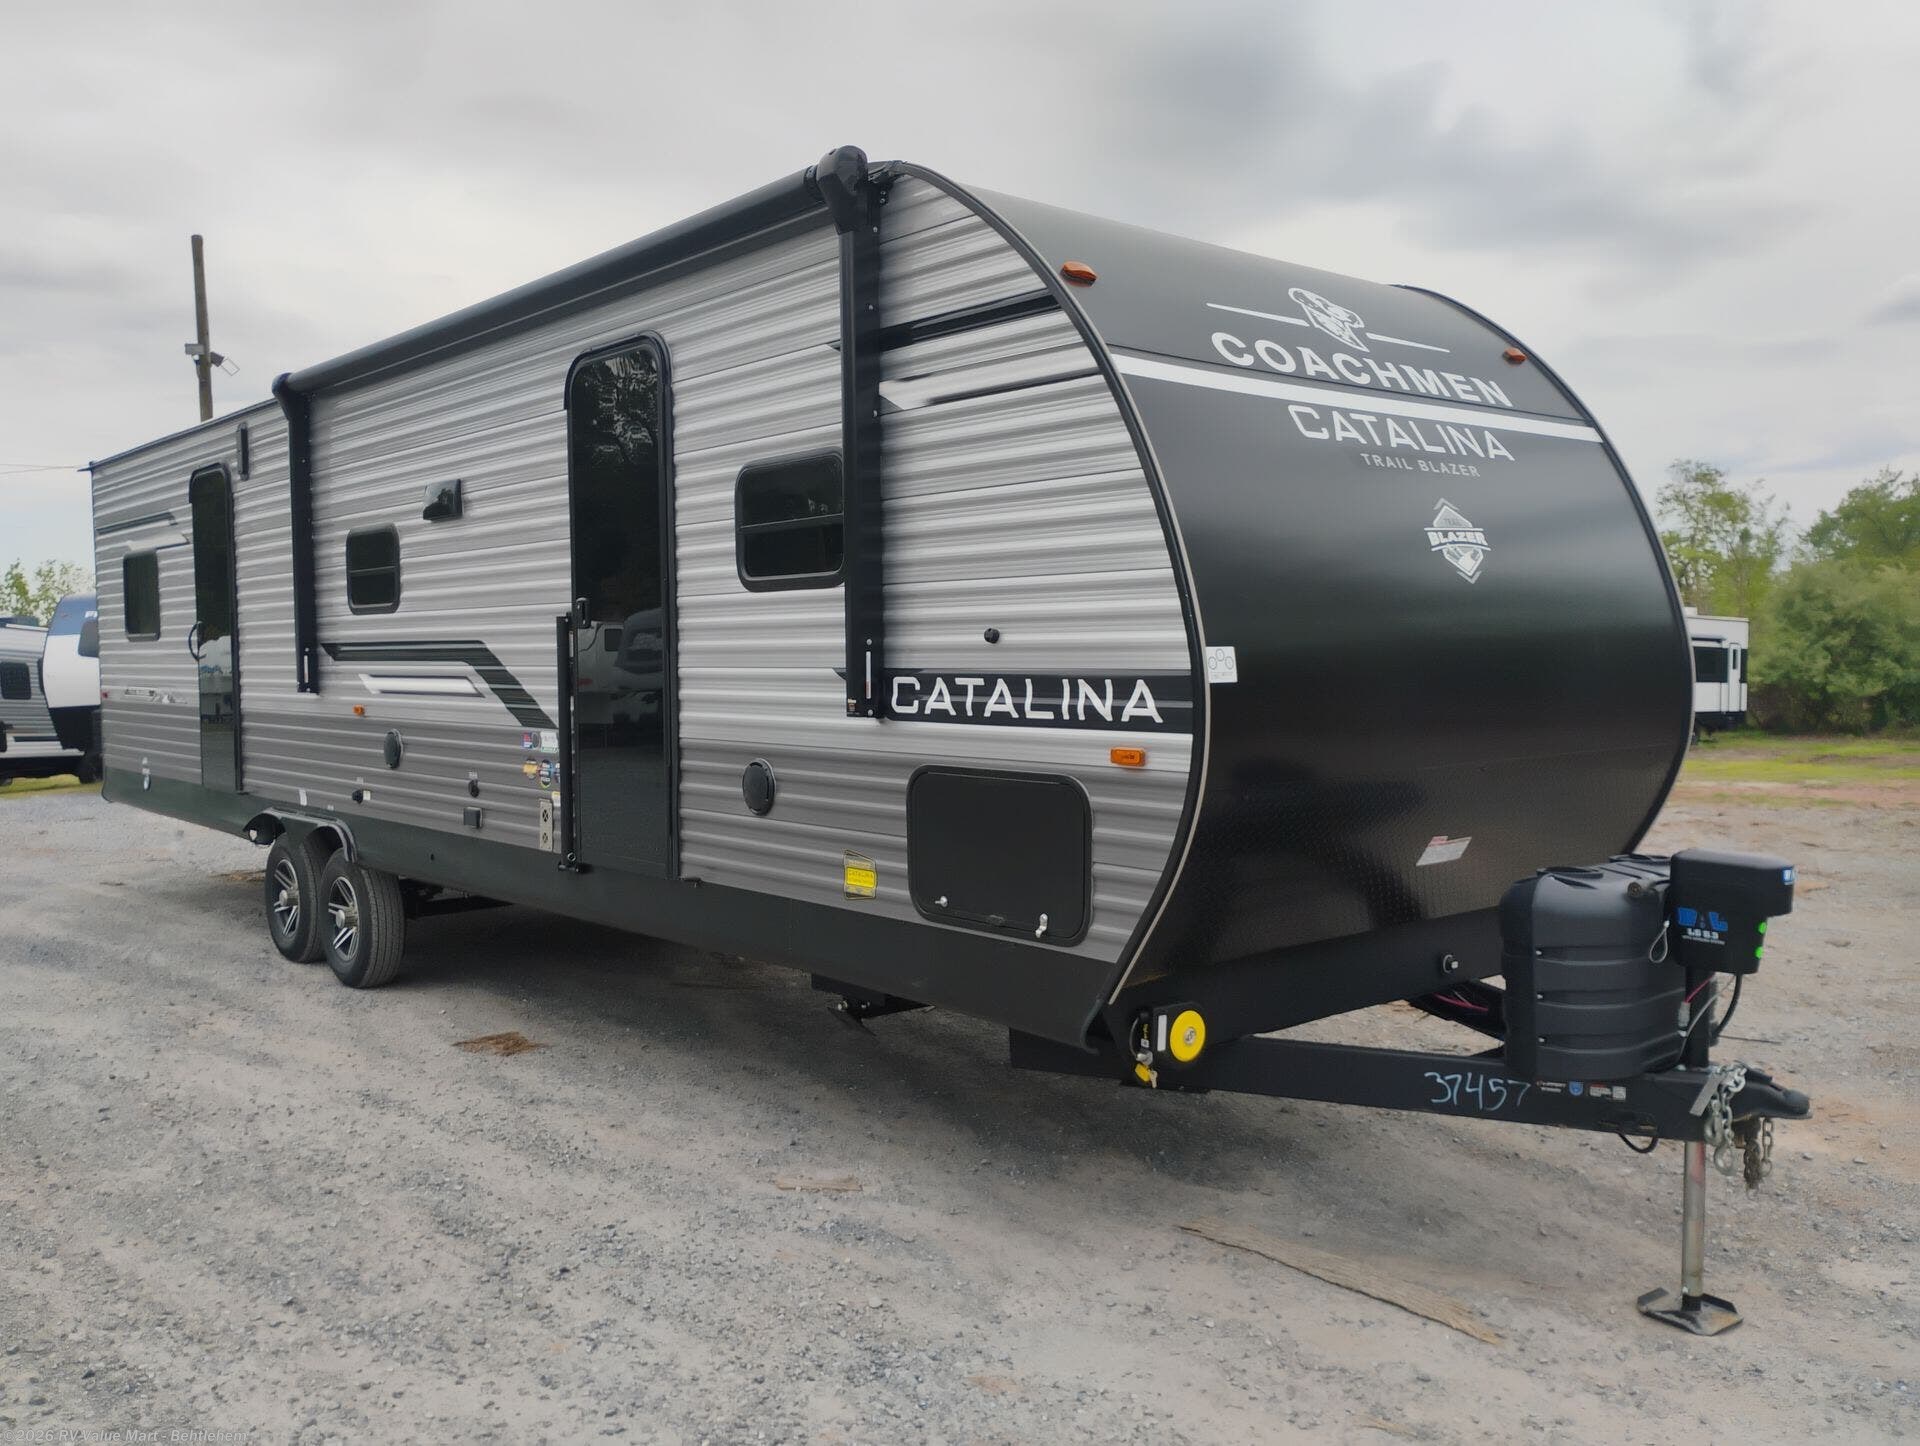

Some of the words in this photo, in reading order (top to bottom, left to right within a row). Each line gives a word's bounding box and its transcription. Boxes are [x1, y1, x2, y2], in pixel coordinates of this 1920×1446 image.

[1211, 332, 1514, 407] COACHMEN
[1287, 404, 1516, 461] CATALINA
[1360, 453, 1413, 470] TRAIL
[1417, 459, 1480, 477] BLAZER
[1427, 531, 1488, 546] BLAZER
[891, 676, 1164, 723] CATALINA
[1424, 1072, 1531, 1111] 37457
